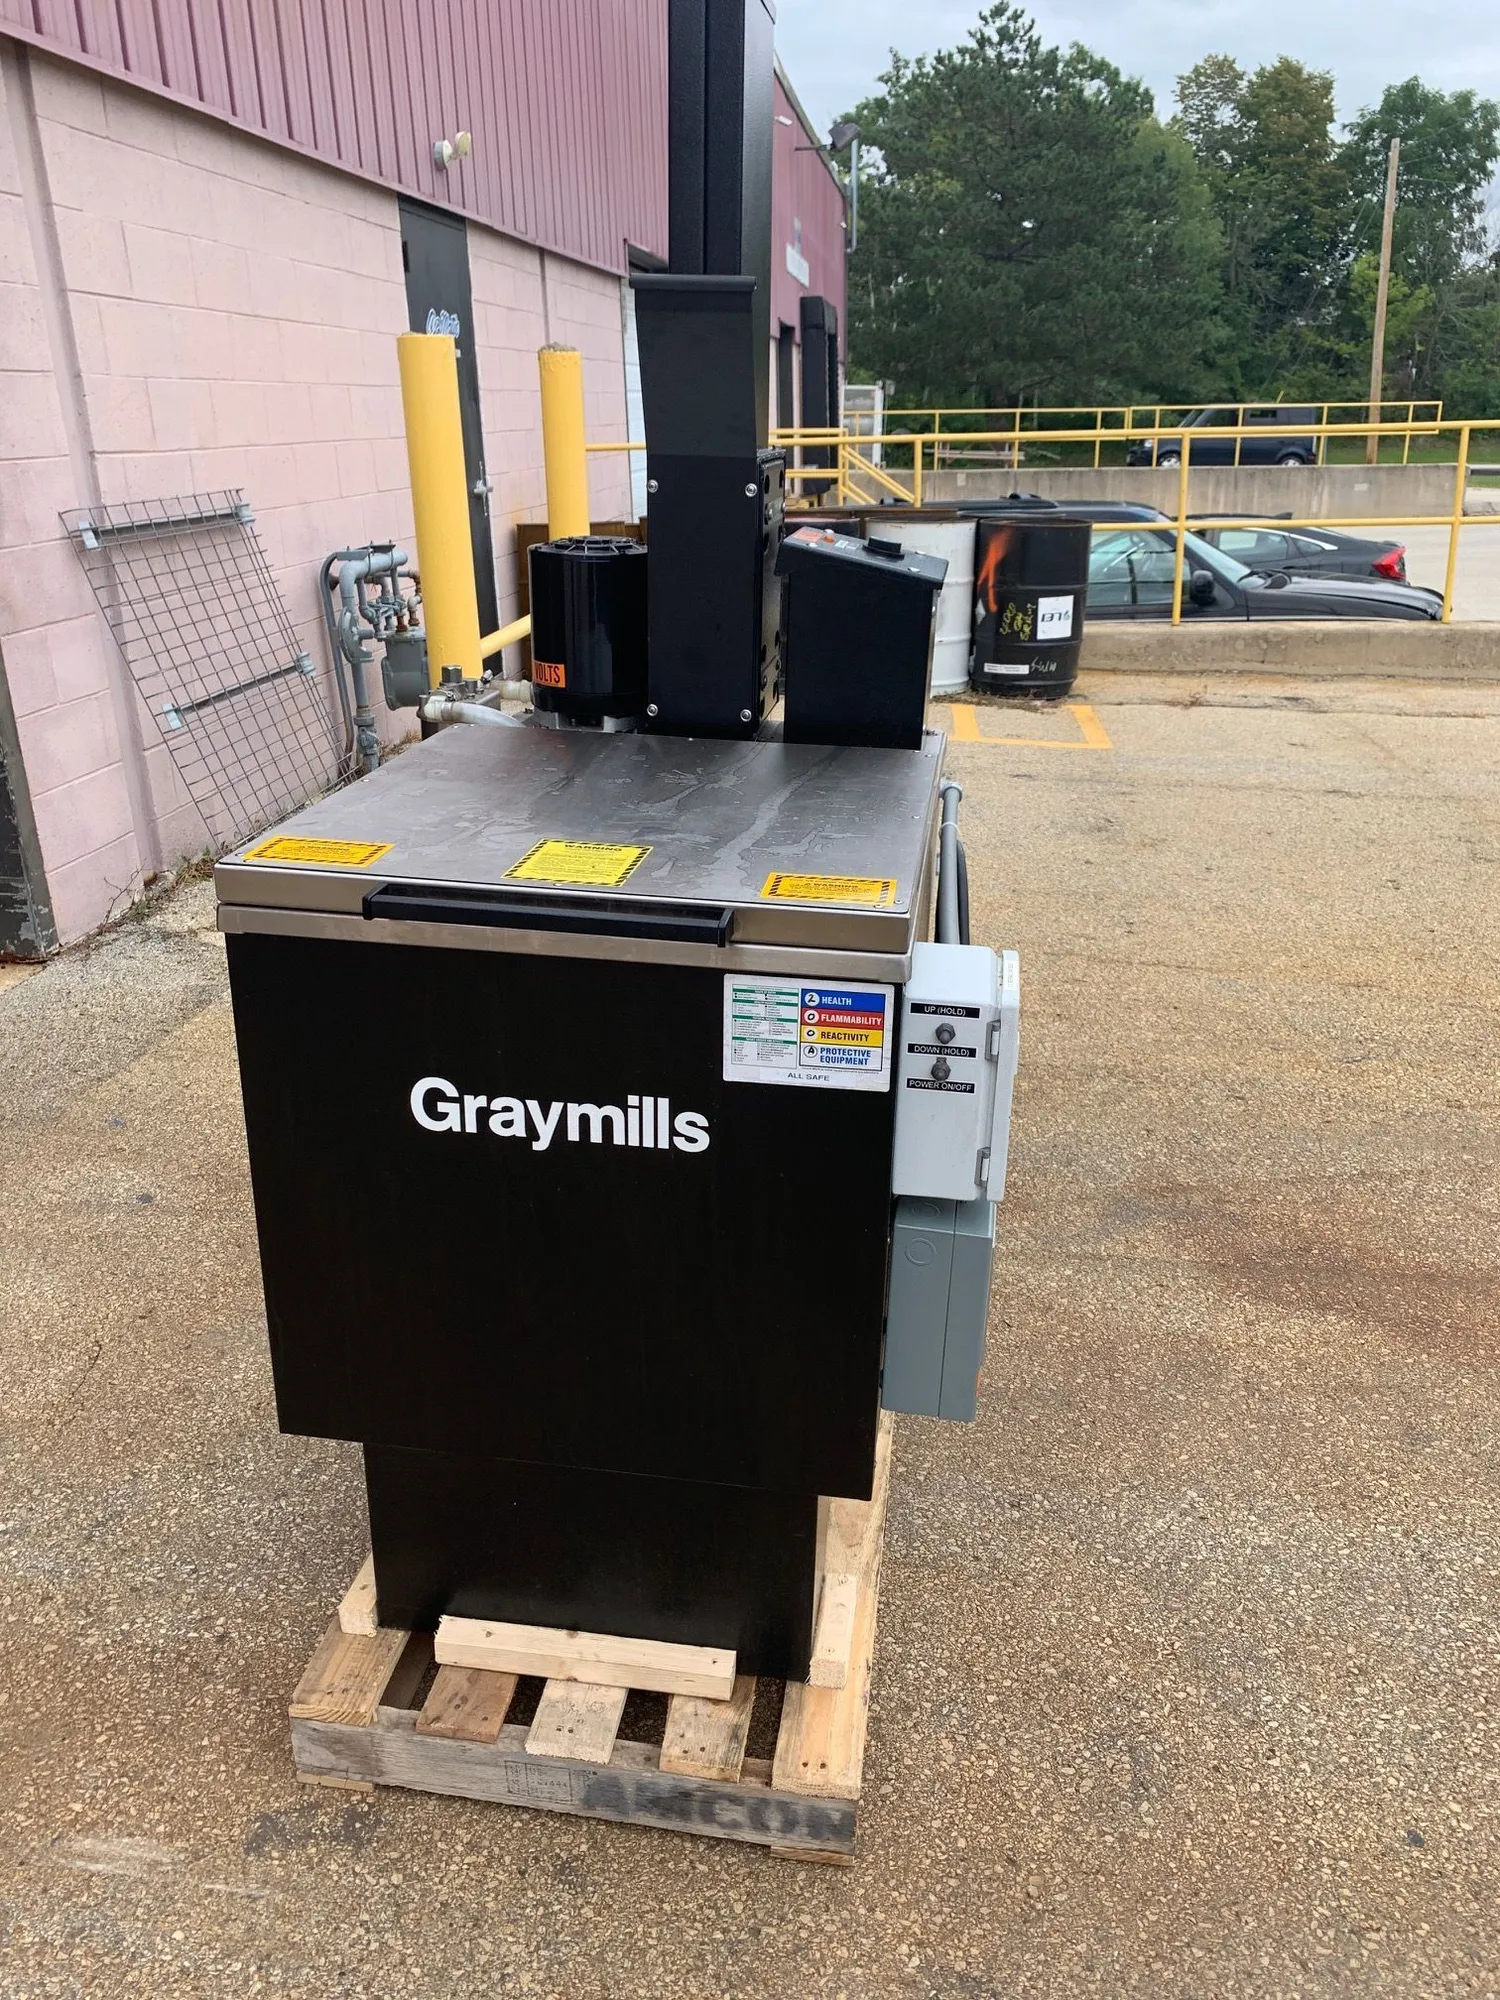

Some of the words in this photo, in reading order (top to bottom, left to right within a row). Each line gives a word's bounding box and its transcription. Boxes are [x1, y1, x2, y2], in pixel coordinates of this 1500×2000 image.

[534, 661, 560, 684] VOLTS
[565, 844, 622, 852] WARNING
[807, 994, 816, 1003] 2
[821, 996, 852, 1006] HEALTH
[937, 1007, 966, 1016] (HOLD)
[821, 1013, 882, 1026] FLAMMABILITY
[820, 1031, 870, 1042] REACTIVITY
[807, 1046, 815, 1055] A
[820, 1047, 872, 1058] PROTECTIVE
[914, 1045, 940, 1054] DOWN
[941, 1047, 970, 1057] (HOLD)
[820, 1055, 869, 1066] EQUIPMENT
[787, 1072, 803, 1080] ALL
[806, 1073, 830, 1082] SAFE
[909, 1080, 940, 1089] POWER
[941, 1082, 972, 1092] ON/OFF
[410, 1076, 710, 1153] Graymills
